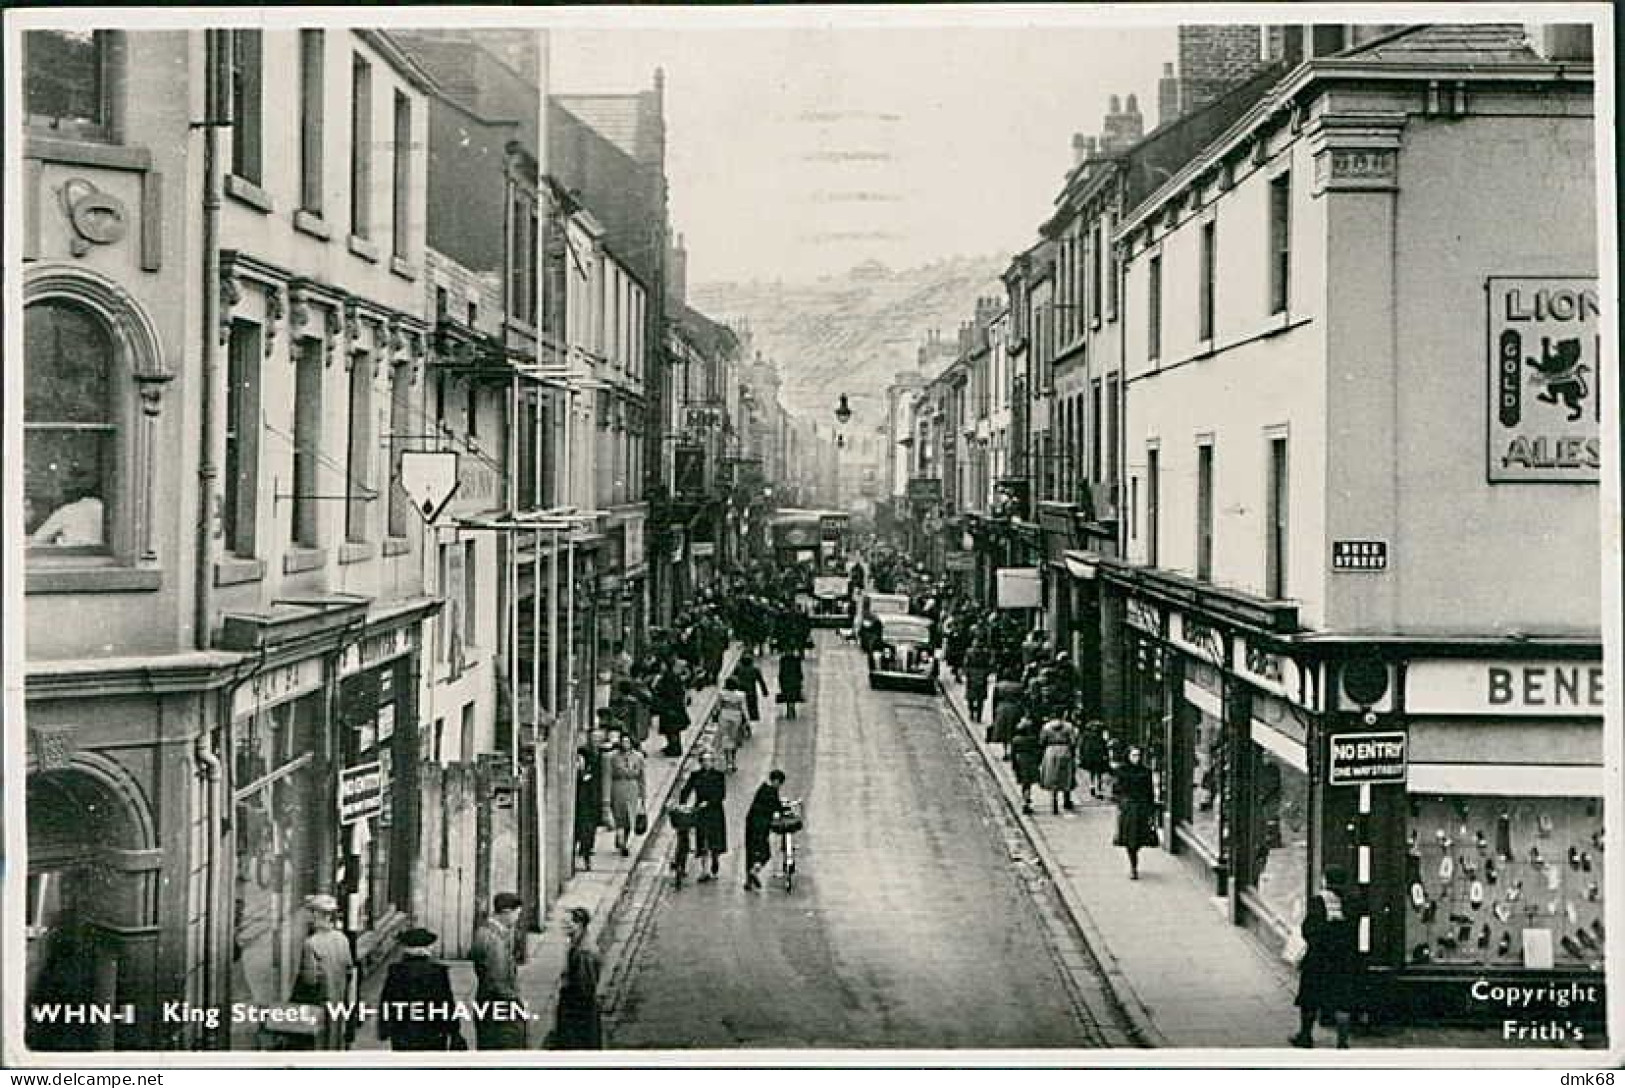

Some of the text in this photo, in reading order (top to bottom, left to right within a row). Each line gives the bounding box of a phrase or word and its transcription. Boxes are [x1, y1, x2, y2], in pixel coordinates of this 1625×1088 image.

[1504, 343, 1518, 408] GOLD
[1334, 741, 1403, 760] NO ENTRY
